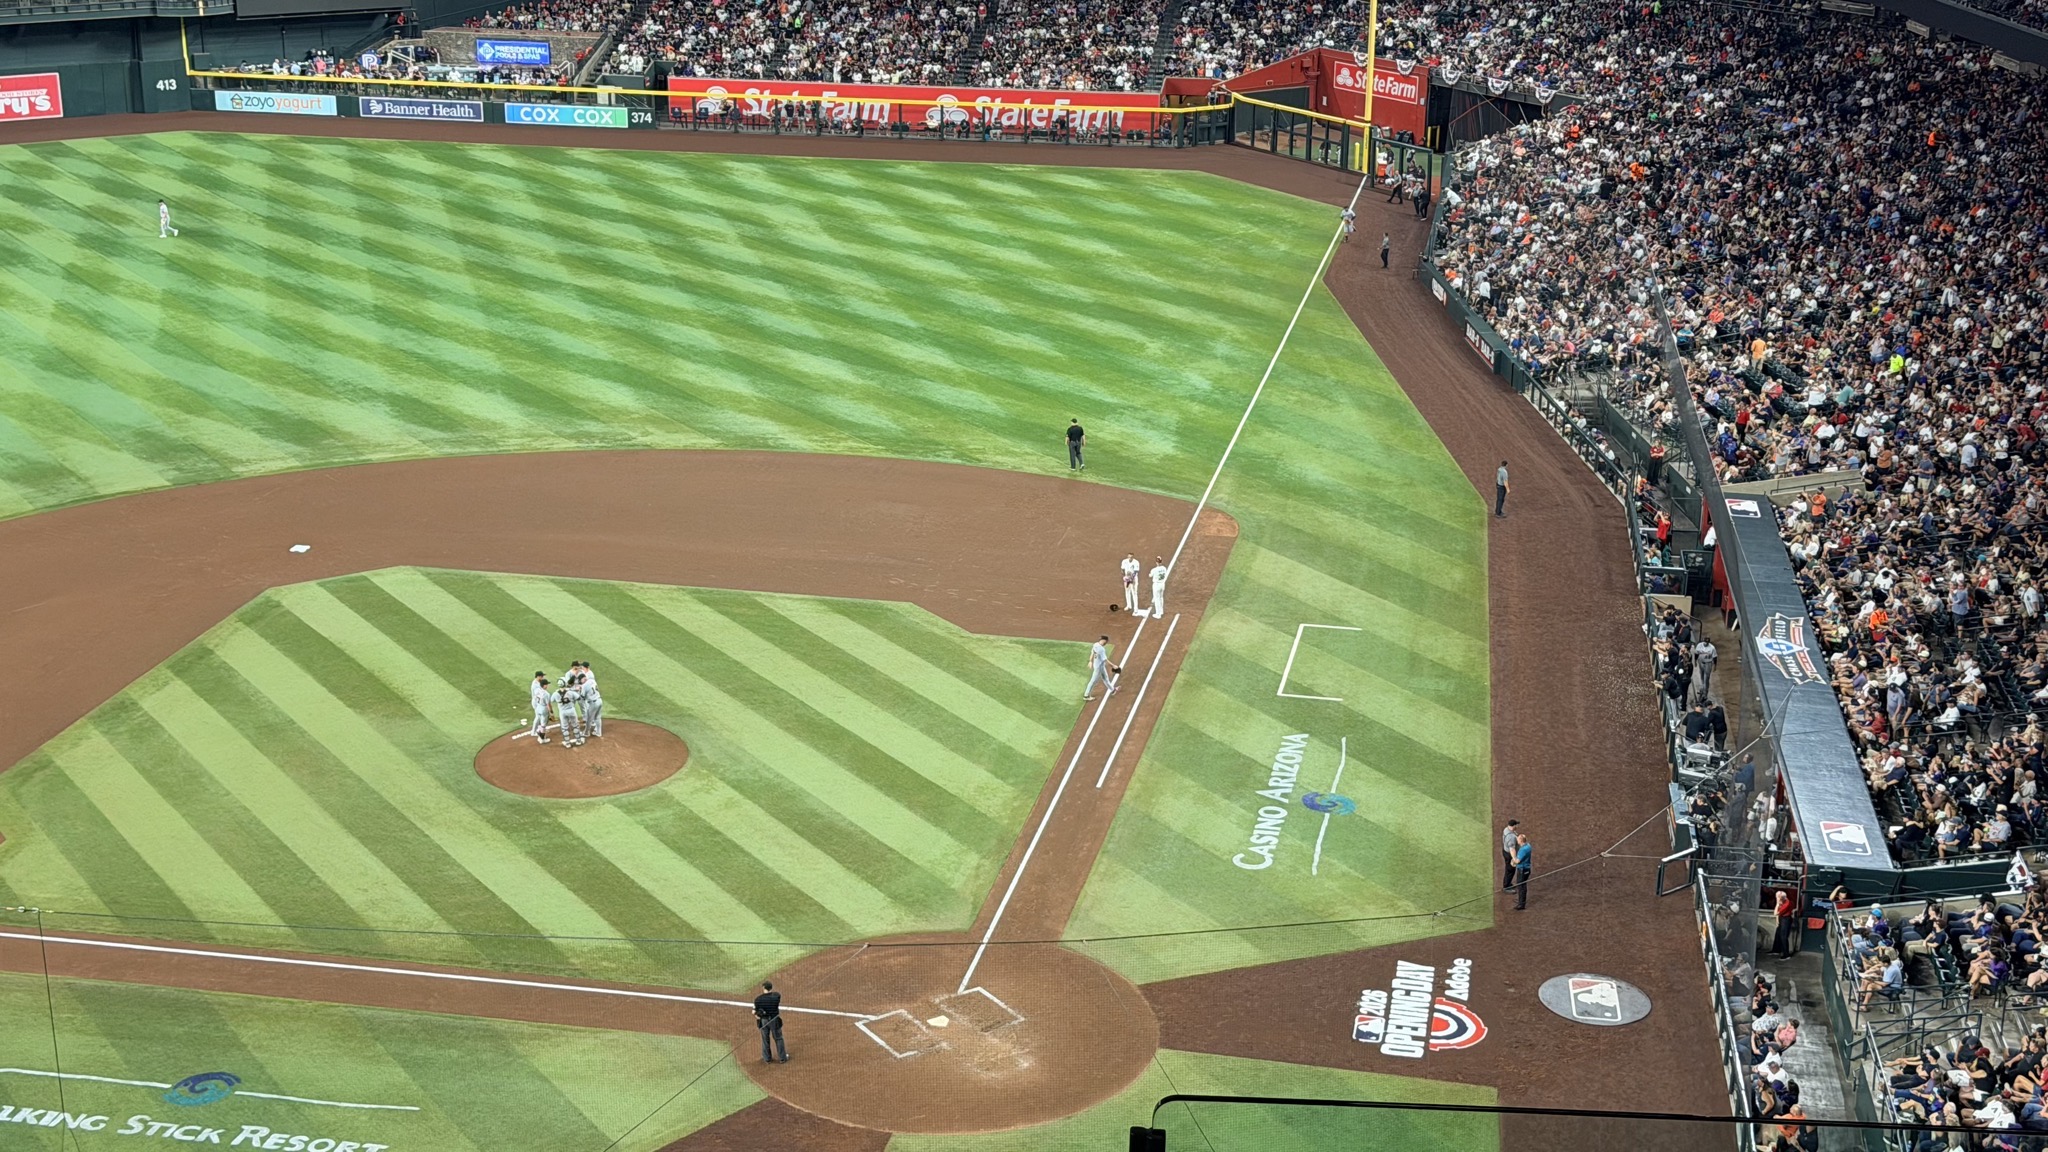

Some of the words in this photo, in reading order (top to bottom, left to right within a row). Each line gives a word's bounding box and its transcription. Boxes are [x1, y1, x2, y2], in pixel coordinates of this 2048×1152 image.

[494, 45, 547, 54] PRESIDENTIAL
[156, 79, 177, 91] 413
[1354, 71, 1385, 92] Stte
[384, 102, 430, 115] Banner
[432, 104, 474, 117] Health
[520, 107, 559, 122] COX
[573, 109, 613, 124] COX
[631, 112, 652, 123] 374
[1775, 620, 1786, 639] FIELD
[1783, 655, 1803, 677] CHASE
[1256, 733, 1309, 803] ARIZONA
[1232, 805, 1288, 870] CASINO
[1444, 958, 1473, 1001] Adobe
[1359, 989, 1388, 1016] 2026
[117, 1114, 226, 1144] STICK
